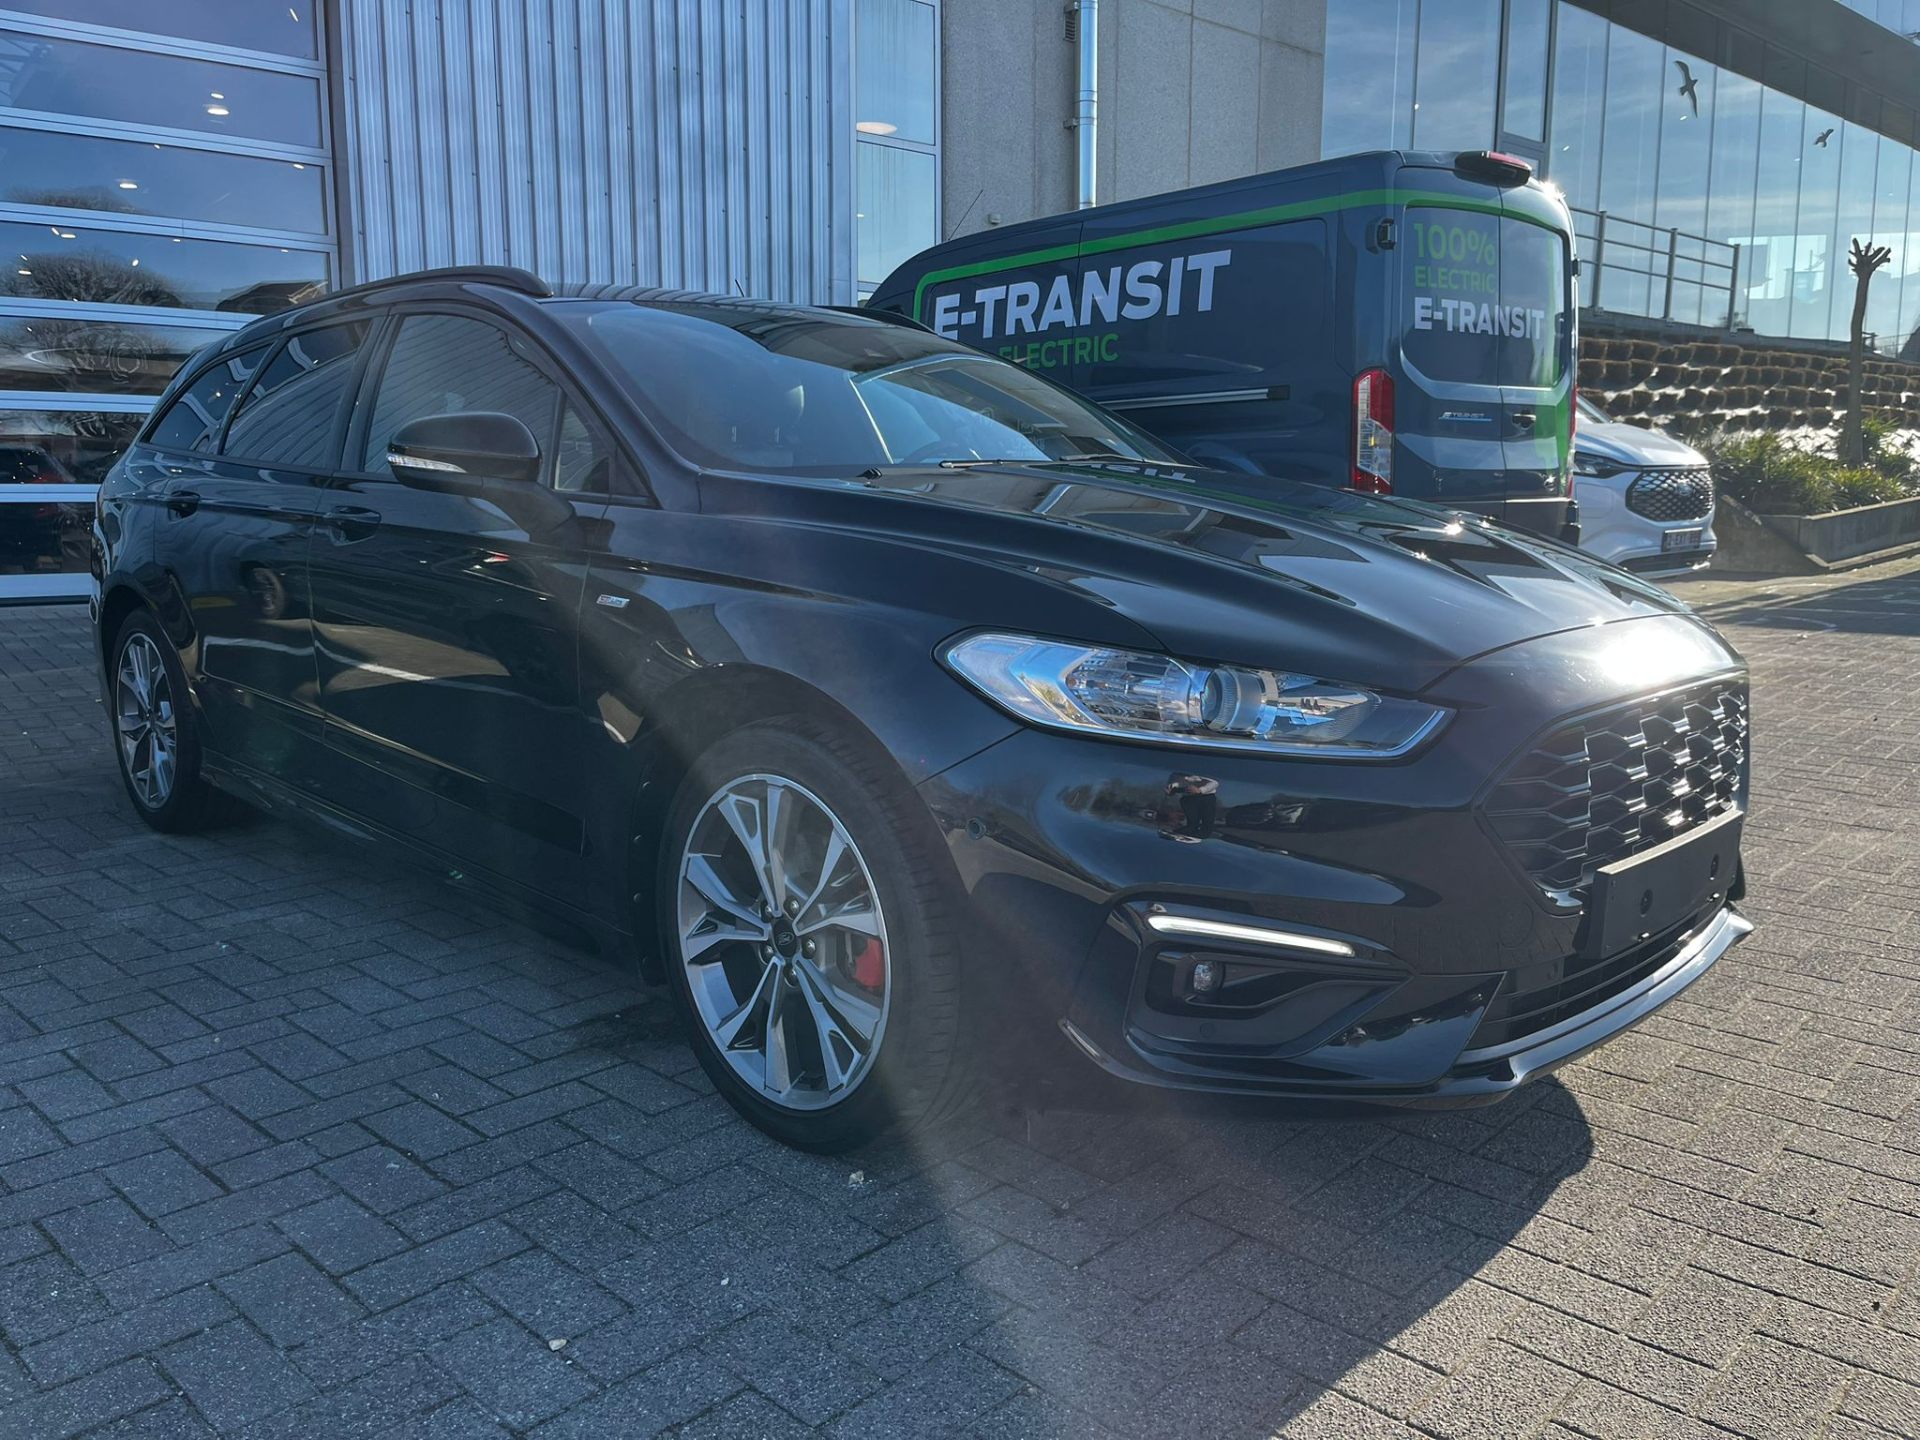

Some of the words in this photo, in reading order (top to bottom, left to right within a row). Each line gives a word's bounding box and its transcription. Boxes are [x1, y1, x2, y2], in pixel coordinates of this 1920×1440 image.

[1413, 223, 1496, 266] 100%
[934, 249, 1232, 340] E-TRANSIT
[1414, 265, 1497, 293] ELECTRIC
[1414, 296, 1545, 340] E-TRANSIT
